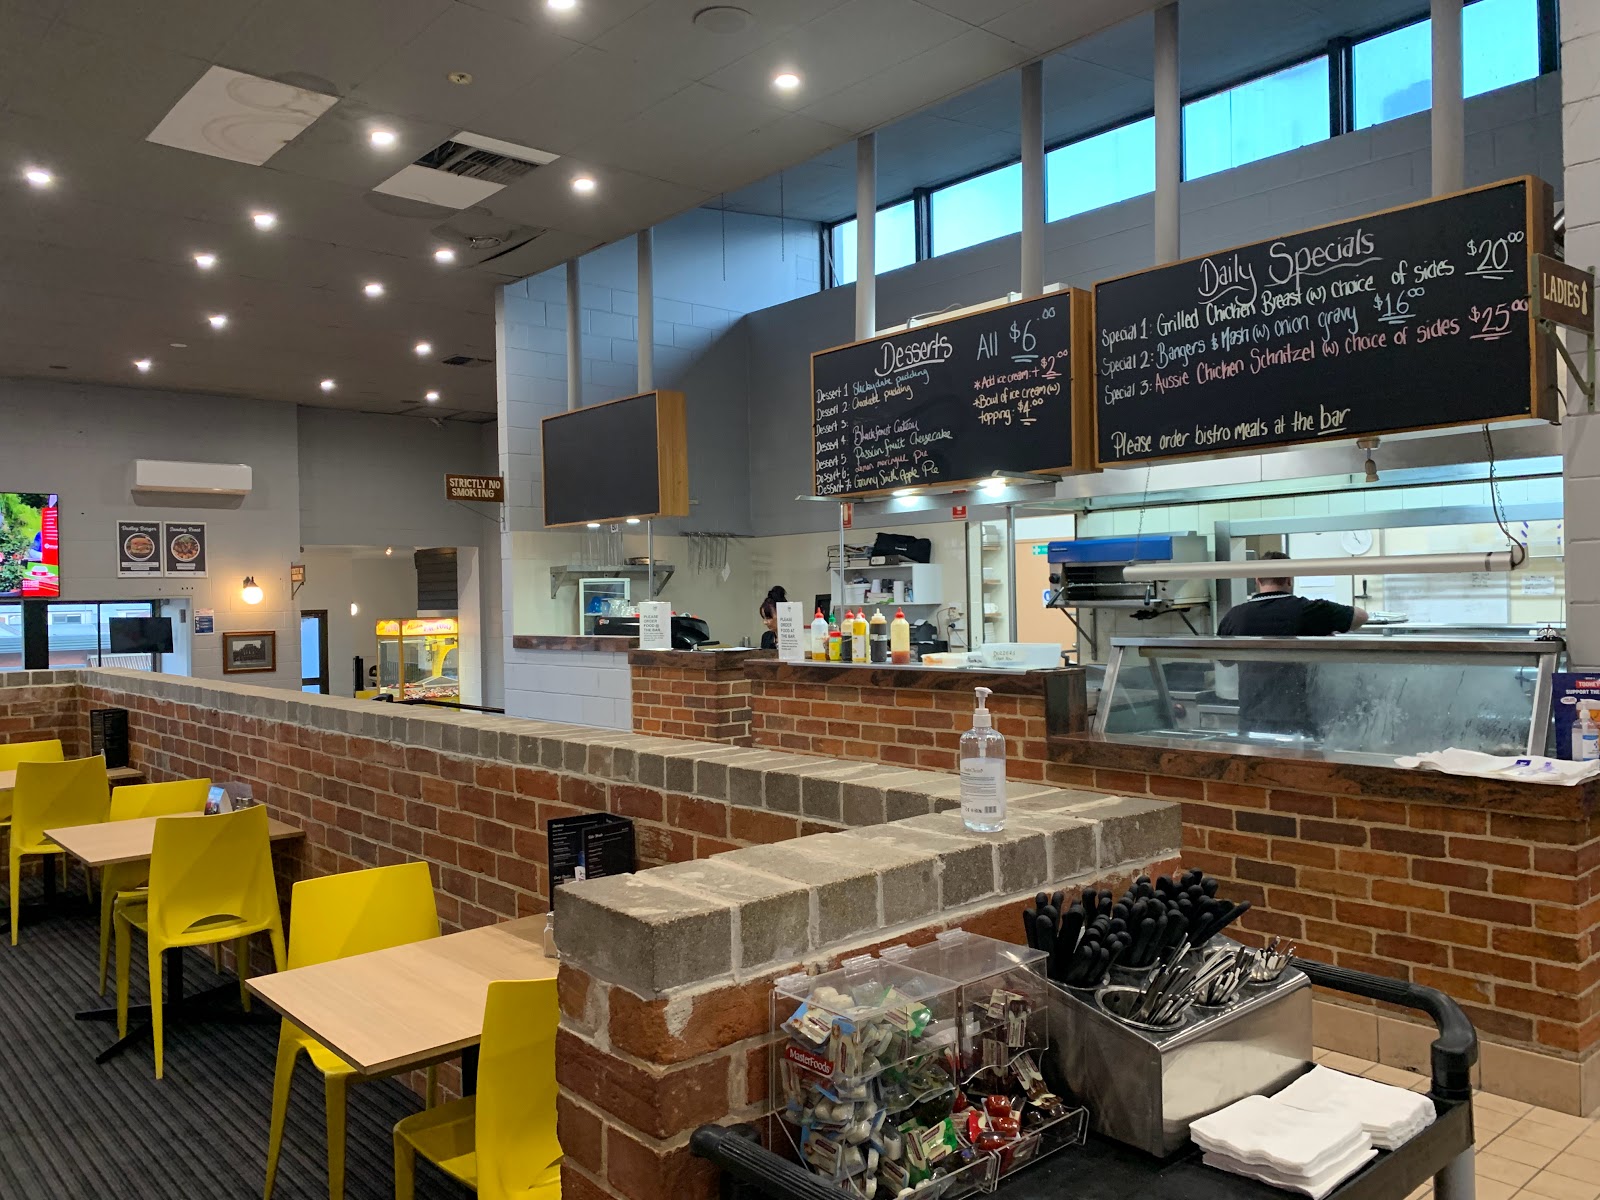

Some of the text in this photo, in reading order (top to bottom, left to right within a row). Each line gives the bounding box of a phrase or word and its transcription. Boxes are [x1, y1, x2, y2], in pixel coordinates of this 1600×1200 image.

[1198, 228, 1375, 306] Daily Specials
[1102, 325, 1136, 353] Special
[1157, 308, 1199, 337] Grilled
[1206, 302, 1256, 326] Chicken
[1261, 290, 1302, 316] Breast
[1391, 260, 1408, 285] of
[1414, 260, 1455, 283] sides
[1543, 272, 1580, 308] LADIES
[874, 332, 953, 377] Desserts
[977, 331, 998, 360] All
[1101, 354, 1136, 379] Special
[1140, 351, 1154, 369] 2:
[1156, 339, 1206, 369] Bangers
[1221, 326, 1250, 352] Mash
[1274, 314, 1309, 336] onion
[1318, 305, 1359, 342] gravy
[997, 374, 1006, 383] ice
[1105, 383, 1135, 405] Special
[1140, 379, 1152, 395] 3:
[1155, 371, 1189, 394] Aussie
[1196, 359, 1245, 385] Chicken
[1250, 340, 1315, 375] Schnitzel
[1345, 333, 1388, 354] choice
[1393, 326, 1409, 345] of
[1416, 318, 1460, 343] sides
[816, 386, 842, 404] Dessert
[895, 368, 929, 388] pudding
[817, 402, 838, 420] Dessert
[884, 384, 914, 402] pudding
[1001, 387, 1008, 403] of
[1010, 388, 1020, 398] ice
[815, 420, 838, 437] Dessert
[1112, 404, 1350, 458] Please order bistro meals at the bar
[816, 437, 839, 455] Dessert
[816, 456, 839, 471] Dessert
[853, 446, 884, 466] Passion
[884, 437, 905, 457] fruit
[450, 478, 501, 489] STRICTLY NO
[854, 474, 879, 489] Granny
[879, 469, 899, 486] Smith
[900, 467, 919, 484] Apple
[922, 460, 940, 477] Pie
[452, 487, 494, 498] SMOKING
[789, 1049, 831, 1074] MasterFoods
